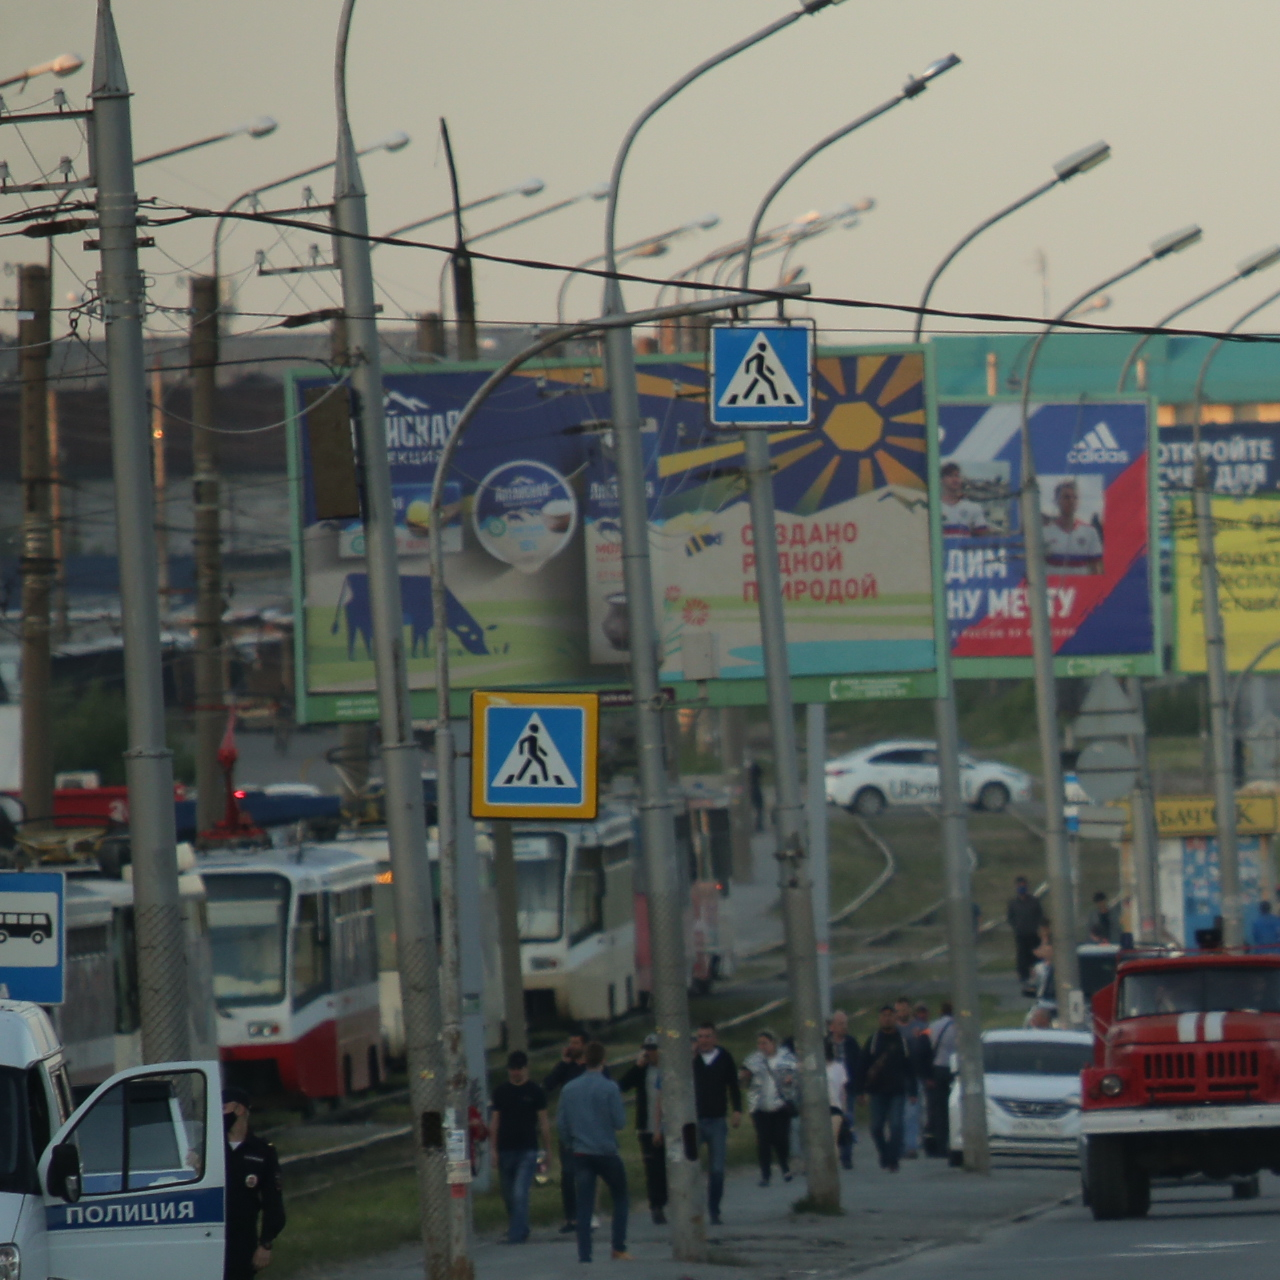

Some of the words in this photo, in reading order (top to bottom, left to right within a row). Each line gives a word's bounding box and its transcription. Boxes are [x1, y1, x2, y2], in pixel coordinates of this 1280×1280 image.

[384, 409, 464, 449] ЙСКАЯ
[1067, 449, 1129, 464] adidas
[740, 521, 858, 549] СЗДАНО
[741, 546, 843, 576] РДНОЙ
[944, 547, 1007, 584] ДИМ
[742, 572, 878, 604] ПИРОДОЙ
[946, 587, 983, 620] НУ
[988, 586, 1077, 620] МЕТУ
[65, 1199, 195, 1225] ПОЛИЦИЯ
